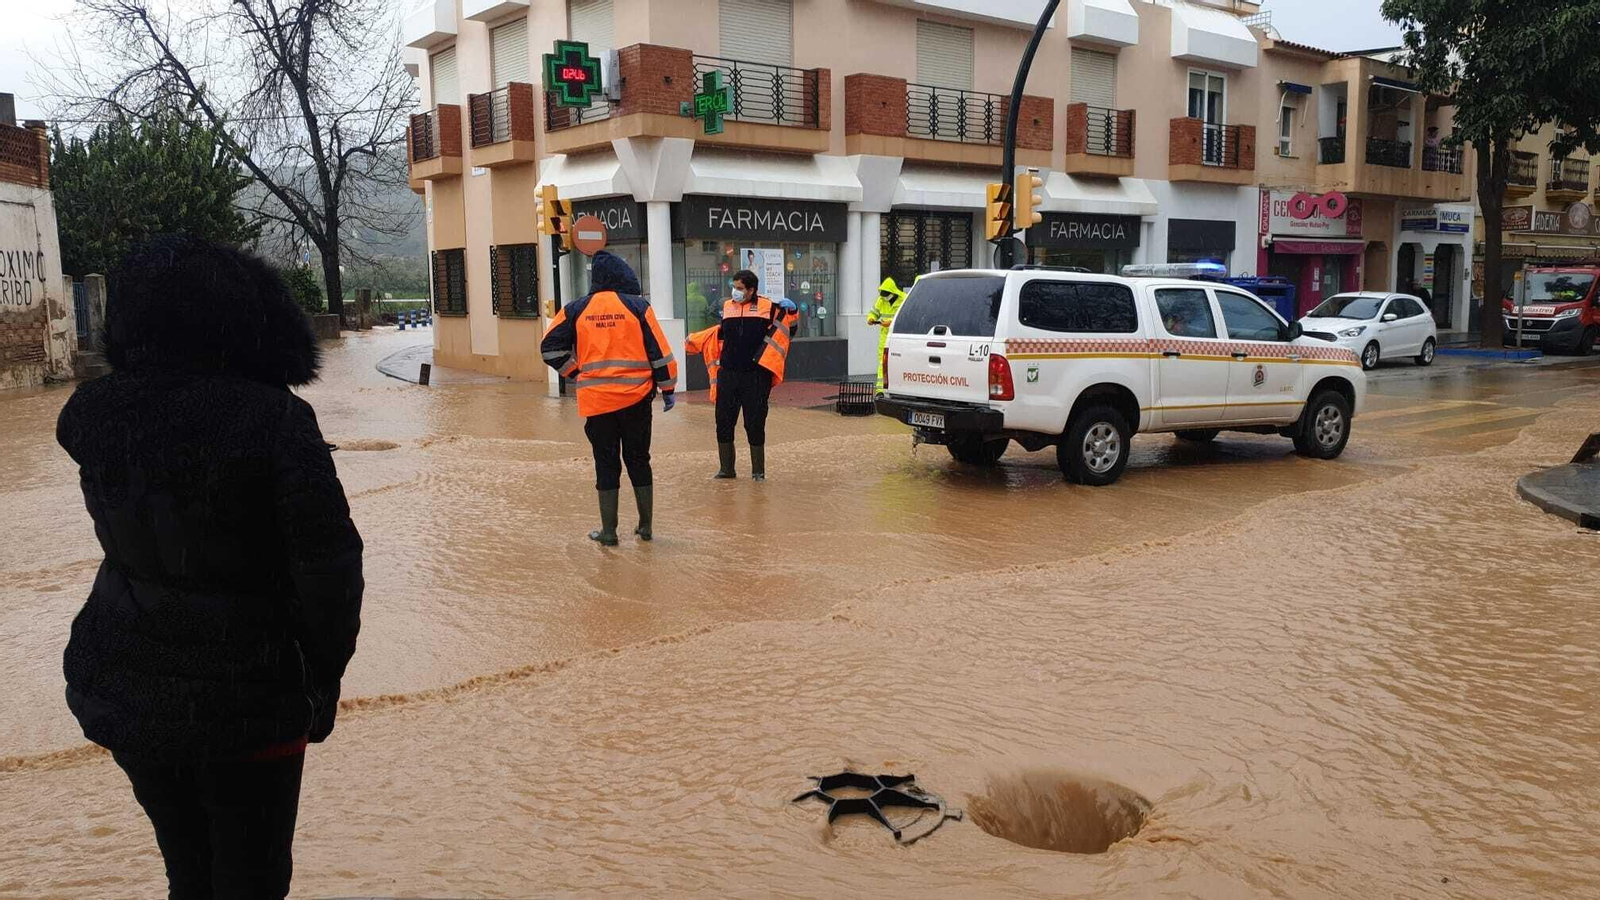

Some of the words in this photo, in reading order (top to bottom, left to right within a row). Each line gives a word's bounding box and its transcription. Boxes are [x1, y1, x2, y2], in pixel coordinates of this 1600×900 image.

[571, 207, 633, 230] AACIA
[708, 207, 825, 233] FARMACIA
[1050, 221, 1126, 240] FARMACIA
[0, 280, 32, 306] RIBO
[969, 343, 989, 356] L-10
[902, 372, 948, 385] PROTECCIÓN
[950, 376, 970, 387] CIVIL
[914, 413, 930, 425] 0049
[931, 415, 944, 427] FVX
